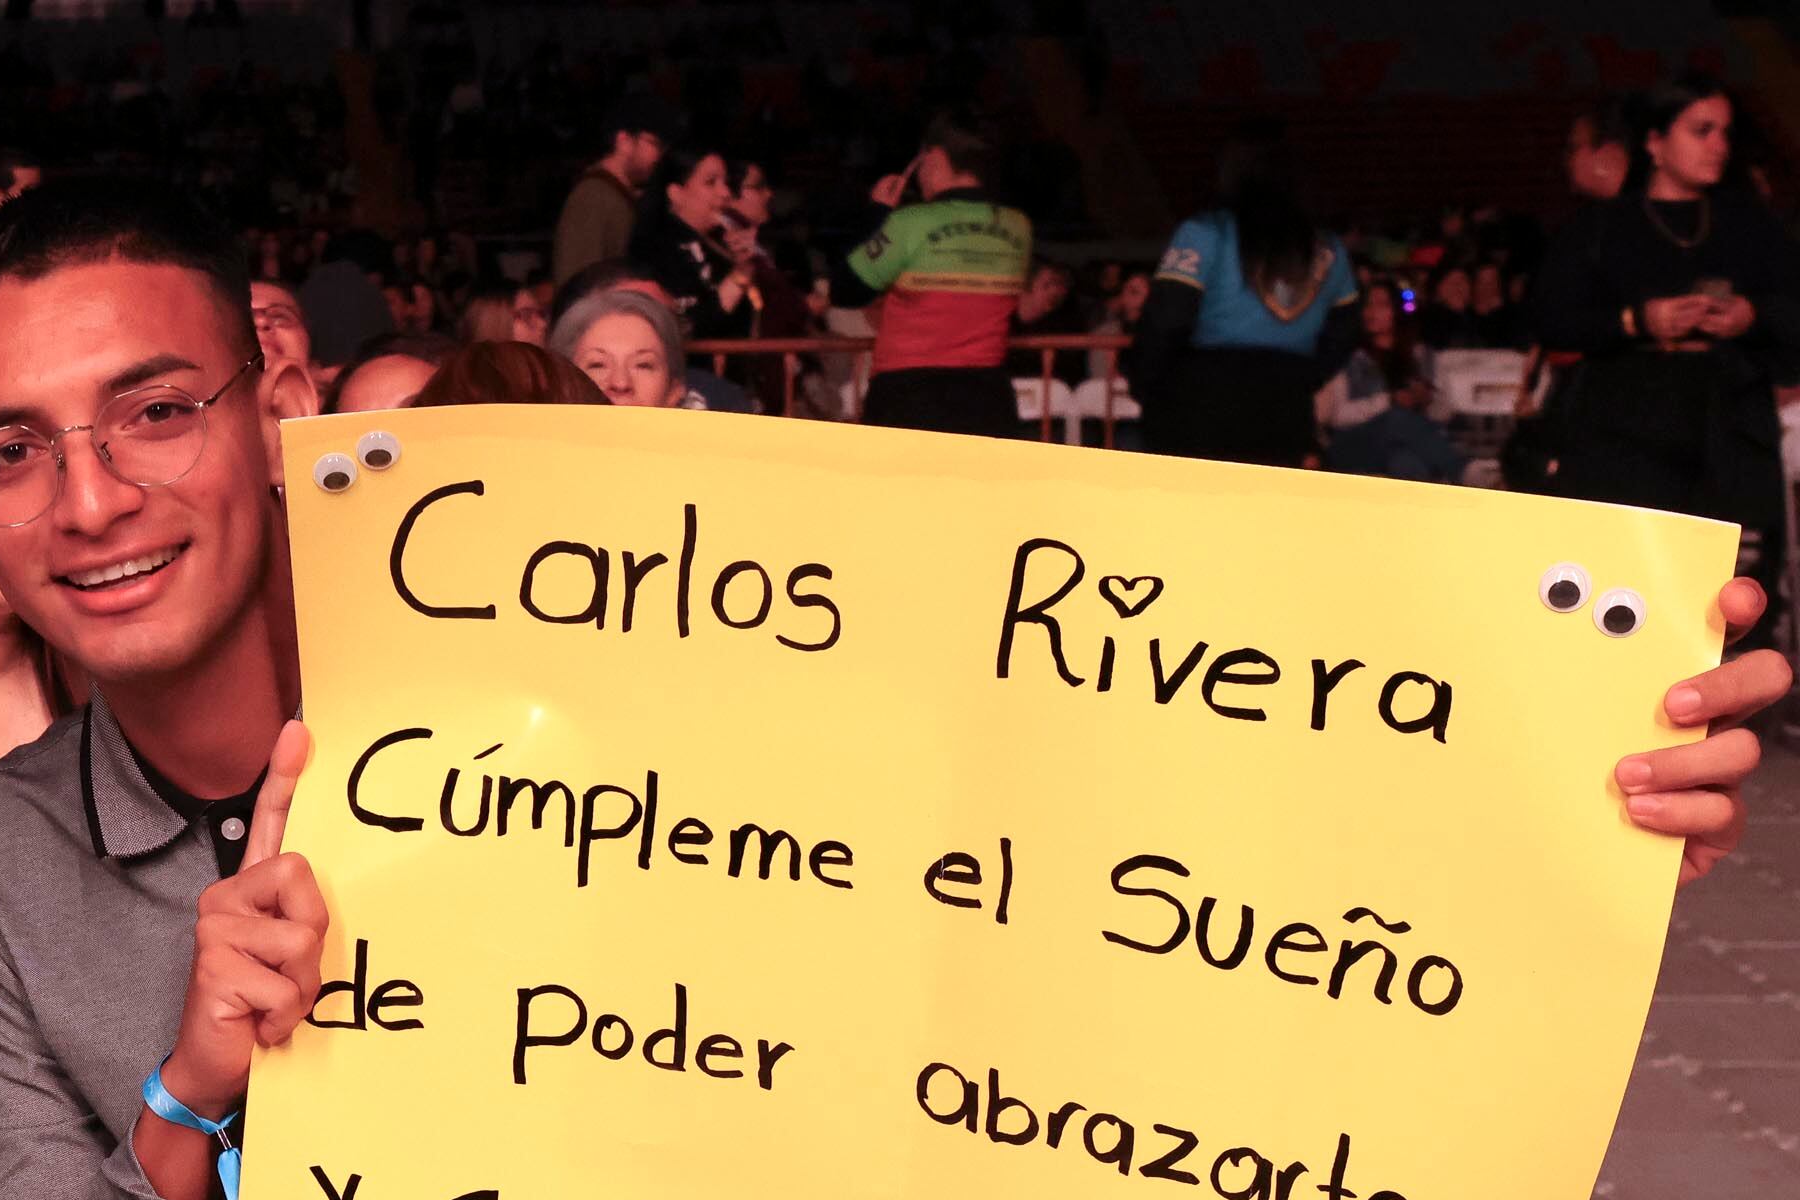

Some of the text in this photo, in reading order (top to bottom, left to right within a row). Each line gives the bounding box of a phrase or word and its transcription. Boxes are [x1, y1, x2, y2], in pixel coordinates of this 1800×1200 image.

[389, 479, 1453, 744] Carlos Rivera
[303, 938, 425, 1031] de
[347, 727, 1464, 1016] Cúmpleme el Sueño
